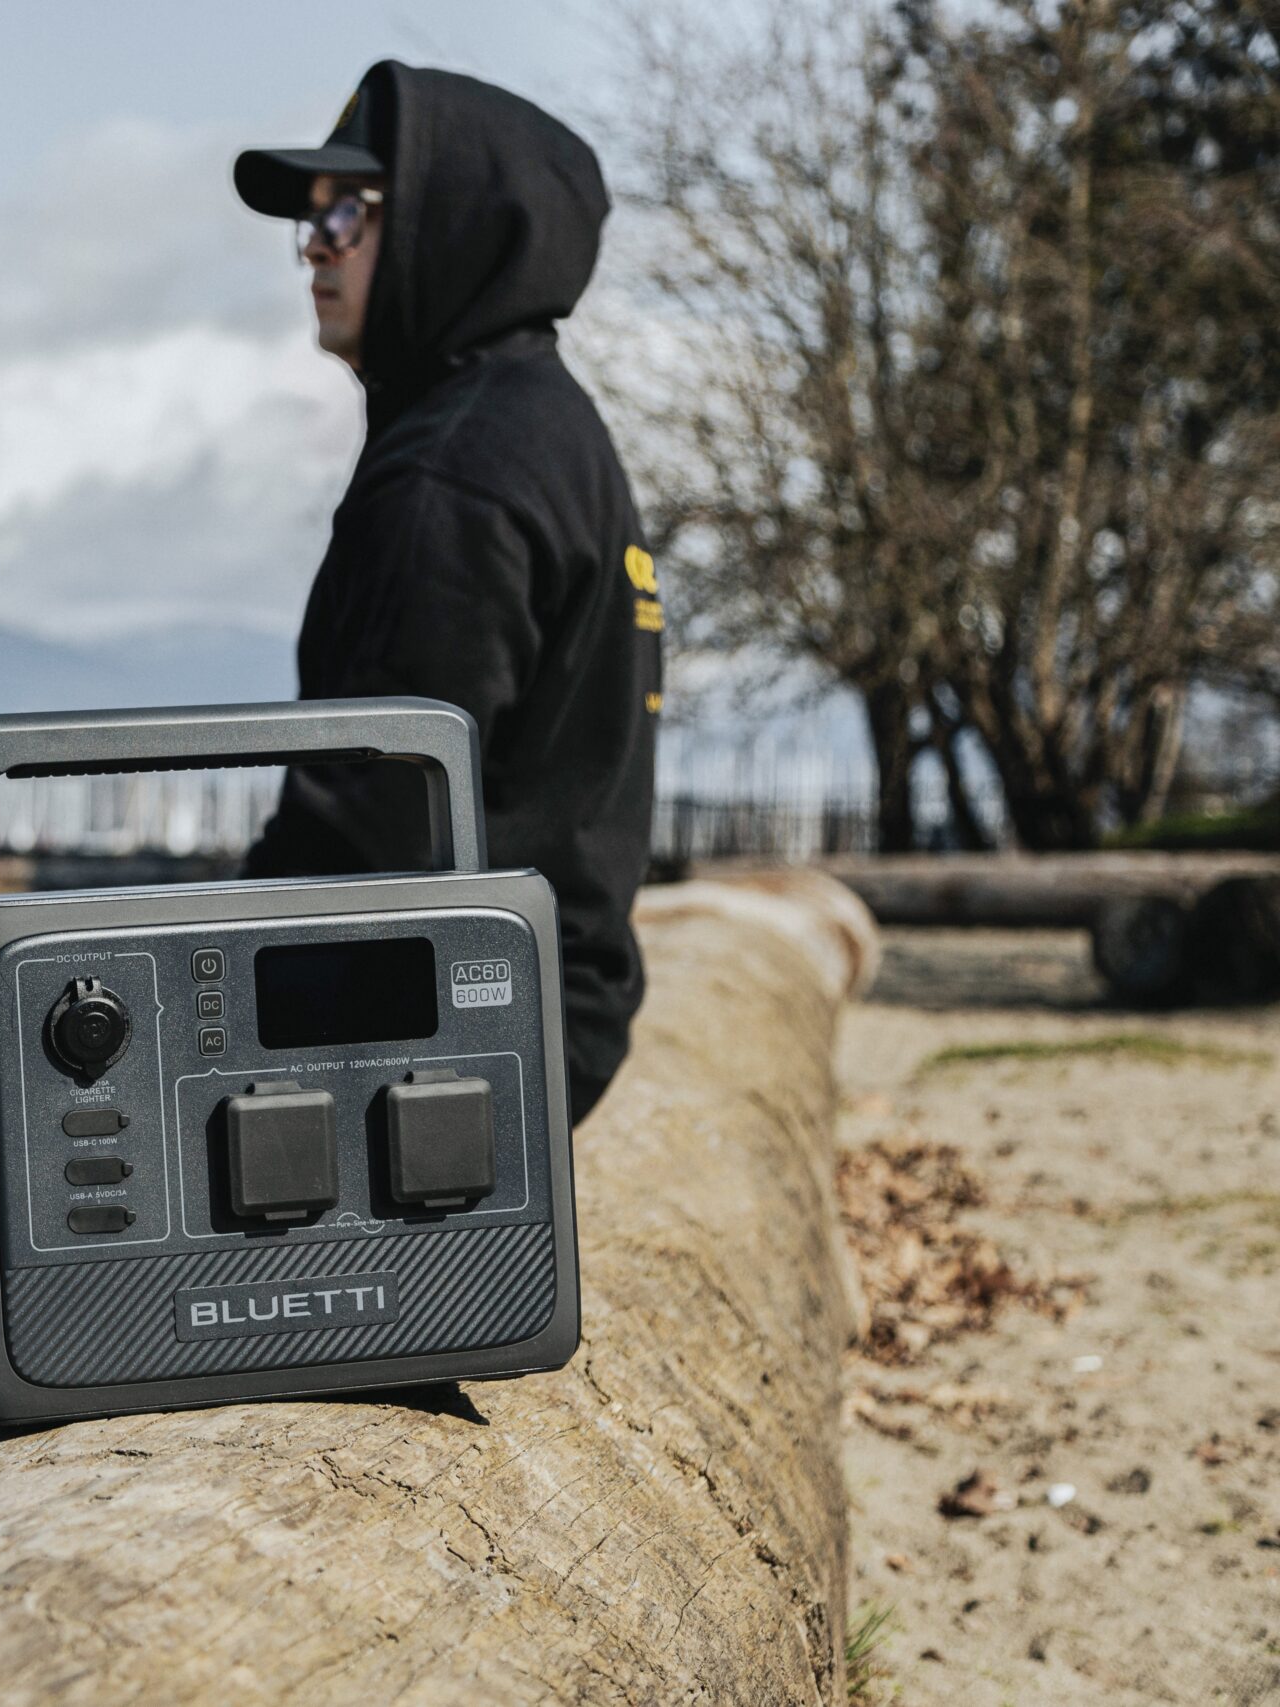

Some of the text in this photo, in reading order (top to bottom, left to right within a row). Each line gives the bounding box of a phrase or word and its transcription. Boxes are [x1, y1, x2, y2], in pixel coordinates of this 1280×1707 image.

[56, 952, 112, 963] DC OUTPUT
[455, 963, 508, 982] AC60
[456, 987, 507, 1004] 600W
[203, 1000, 219, 1010] DC
[205, 1036, 222, 1047] AC
[290, 1056, 410, 1073] AC OUTPUT 120VAC/600W
[69, 1086, 116, 1096] CIGARETTE
[75, 1094, 111, 1104] LIGHTER
[73, 1137, 117, 1147] USB-C 100W
[69, 1190, 127, 1200] USB-A 5VDC/3A
[190, 1285, 384, 1327] BLUETTI
